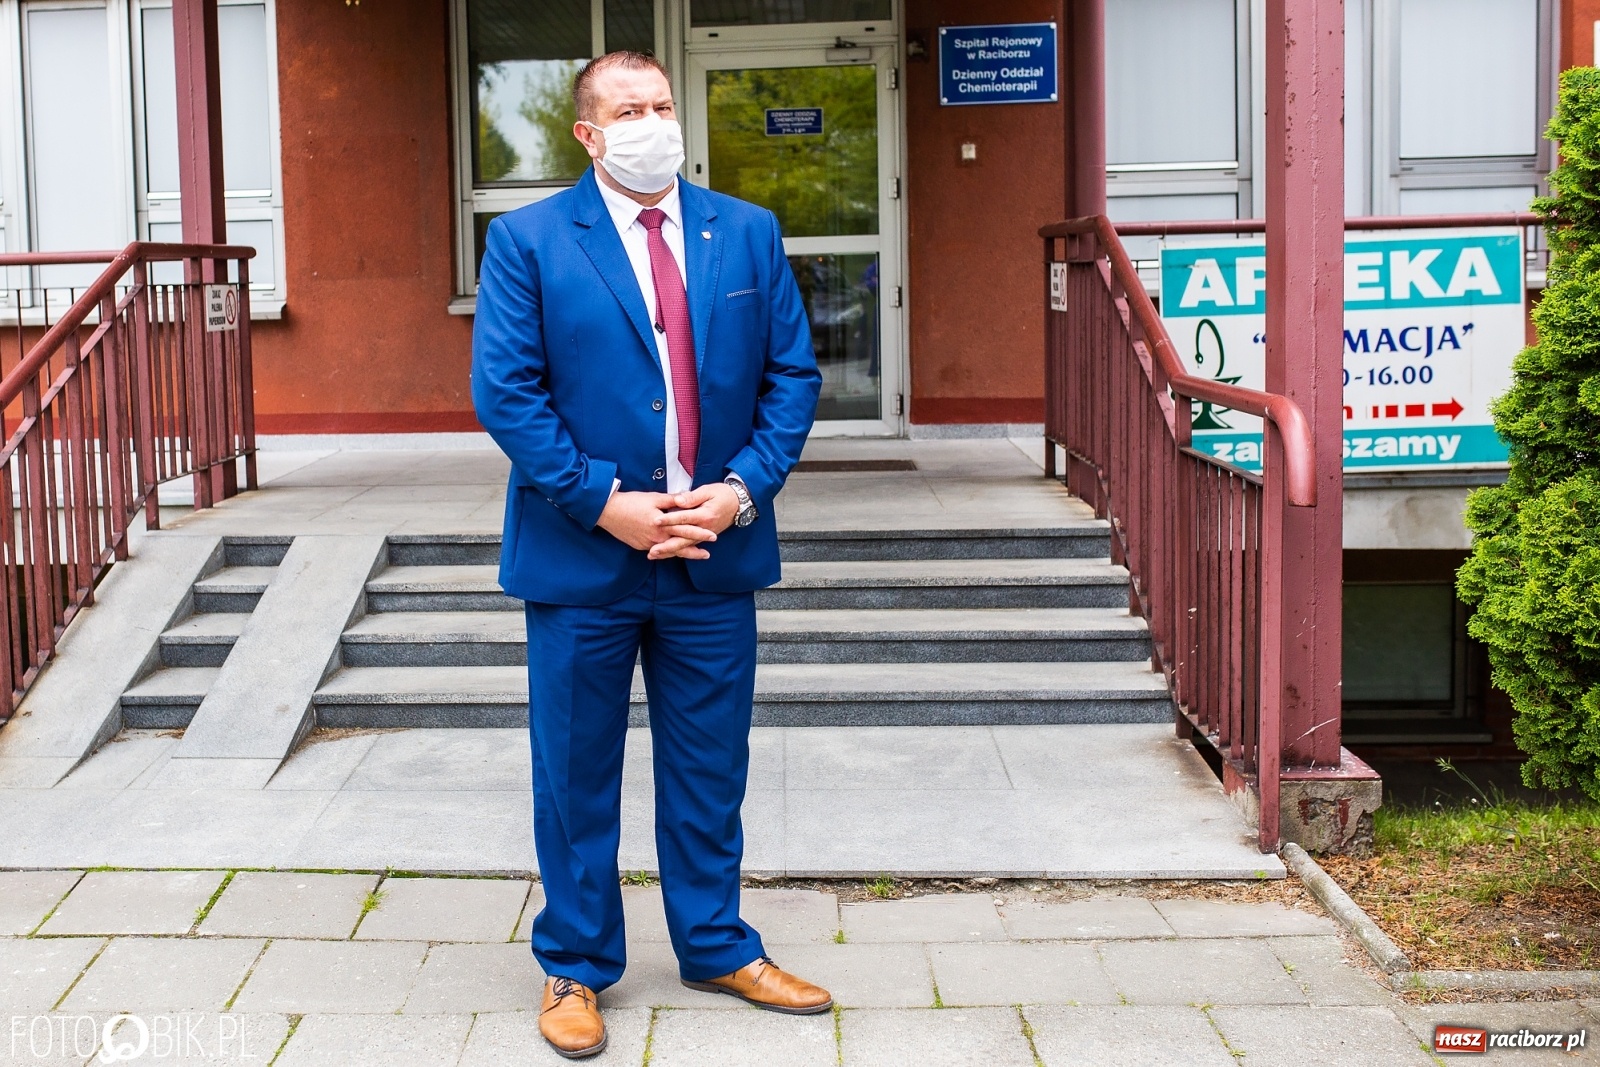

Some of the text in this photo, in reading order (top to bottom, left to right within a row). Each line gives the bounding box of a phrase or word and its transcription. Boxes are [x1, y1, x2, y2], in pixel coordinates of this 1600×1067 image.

[954, 37, 1043, 50] Szpital Rejonowy
[967, 50, 1031, 60] w Raciborzu
[952, 67, 1044, 81] Dzienny Oddział
[958, 80, 1038, 93] Chemioterapii
[1179, 247, 1502, 308] APEKA
